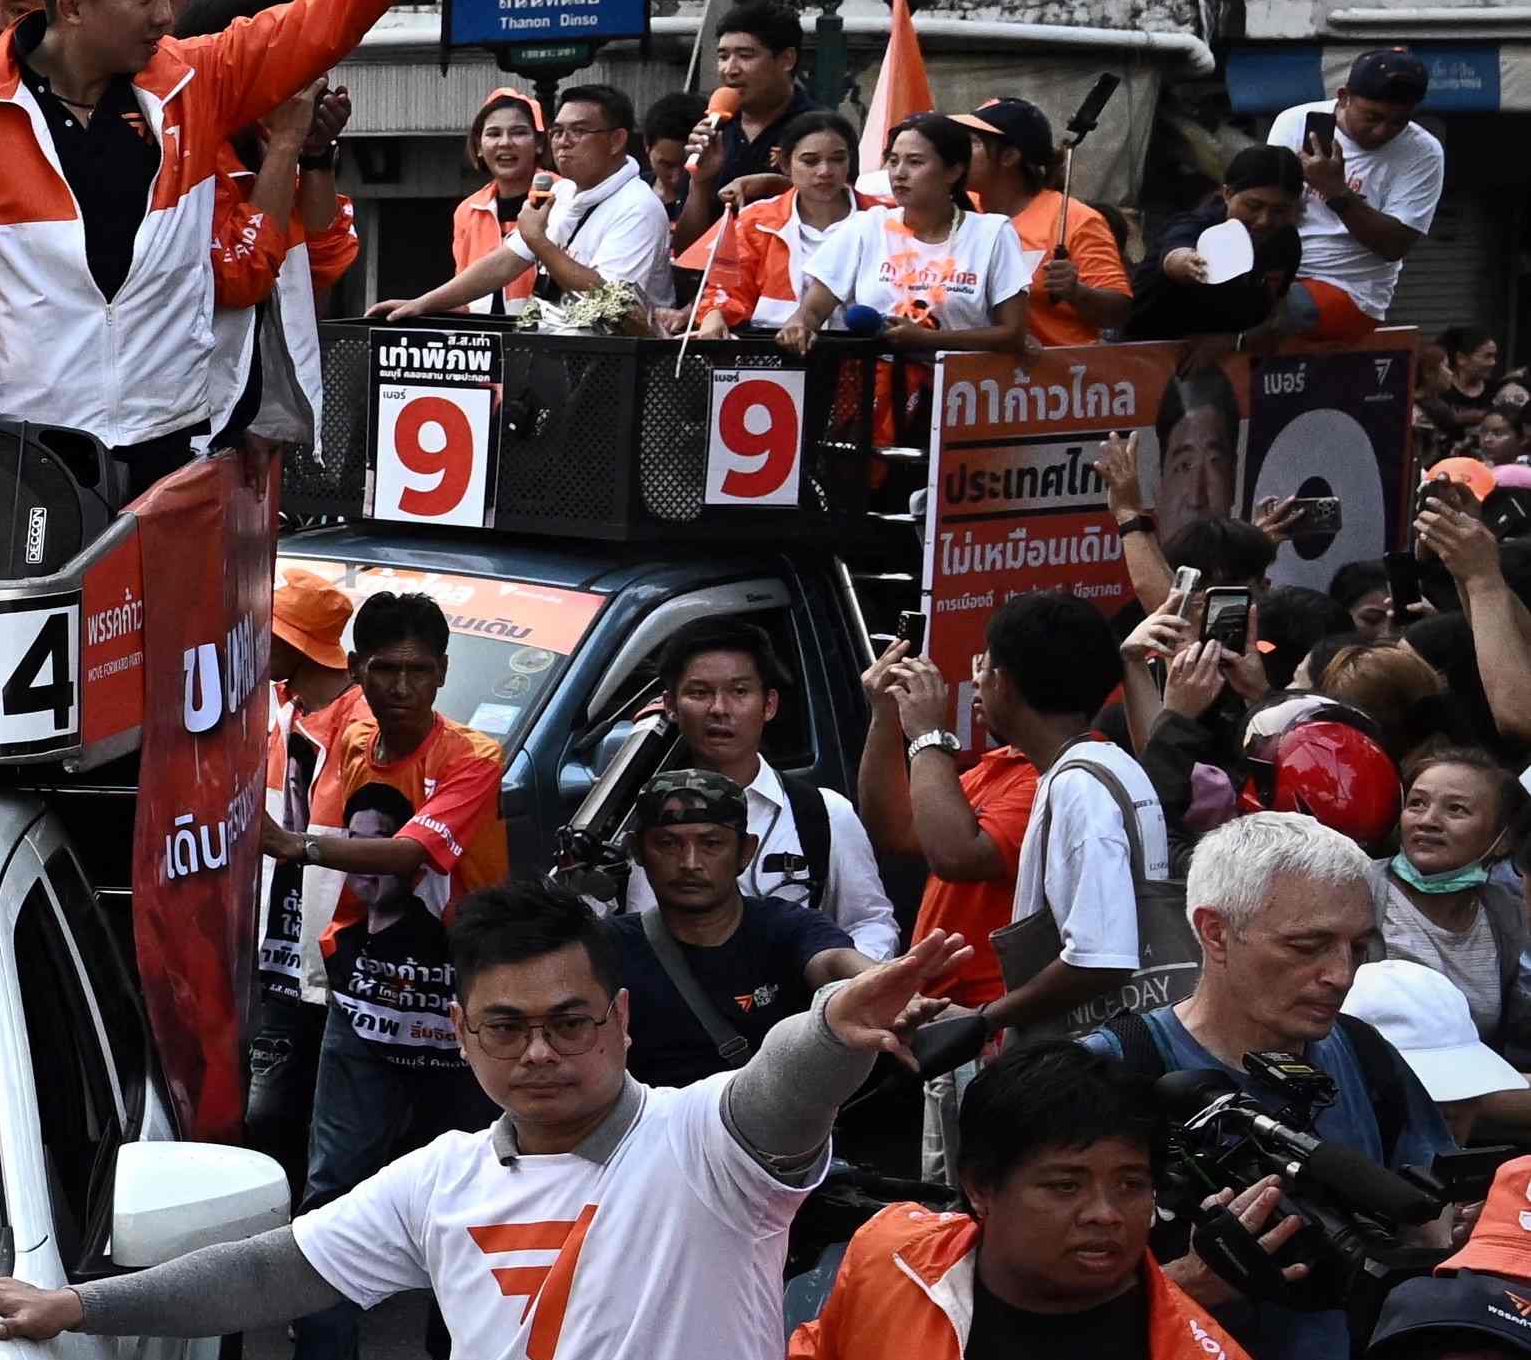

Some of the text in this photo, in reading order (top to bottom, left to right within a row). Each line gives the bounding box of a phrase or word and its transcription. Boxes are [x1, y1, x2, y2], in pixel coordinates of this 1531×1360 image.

[500, 13, 599, 31] Thanon Dinso
[379, 337, 492, 372] เท่าพิภพ
[1264, 362, 1306, 396] เบอร์
[946, 365, 1137, 428] กาก้าวไกล
[393, 395, 474, 518] 9
[718, 378, 800, 499] 9
[29, 509, 46, 561] DECCON
[1, 613, 75, 733] 4
[1121, 975, 1171, 1012] DAY
